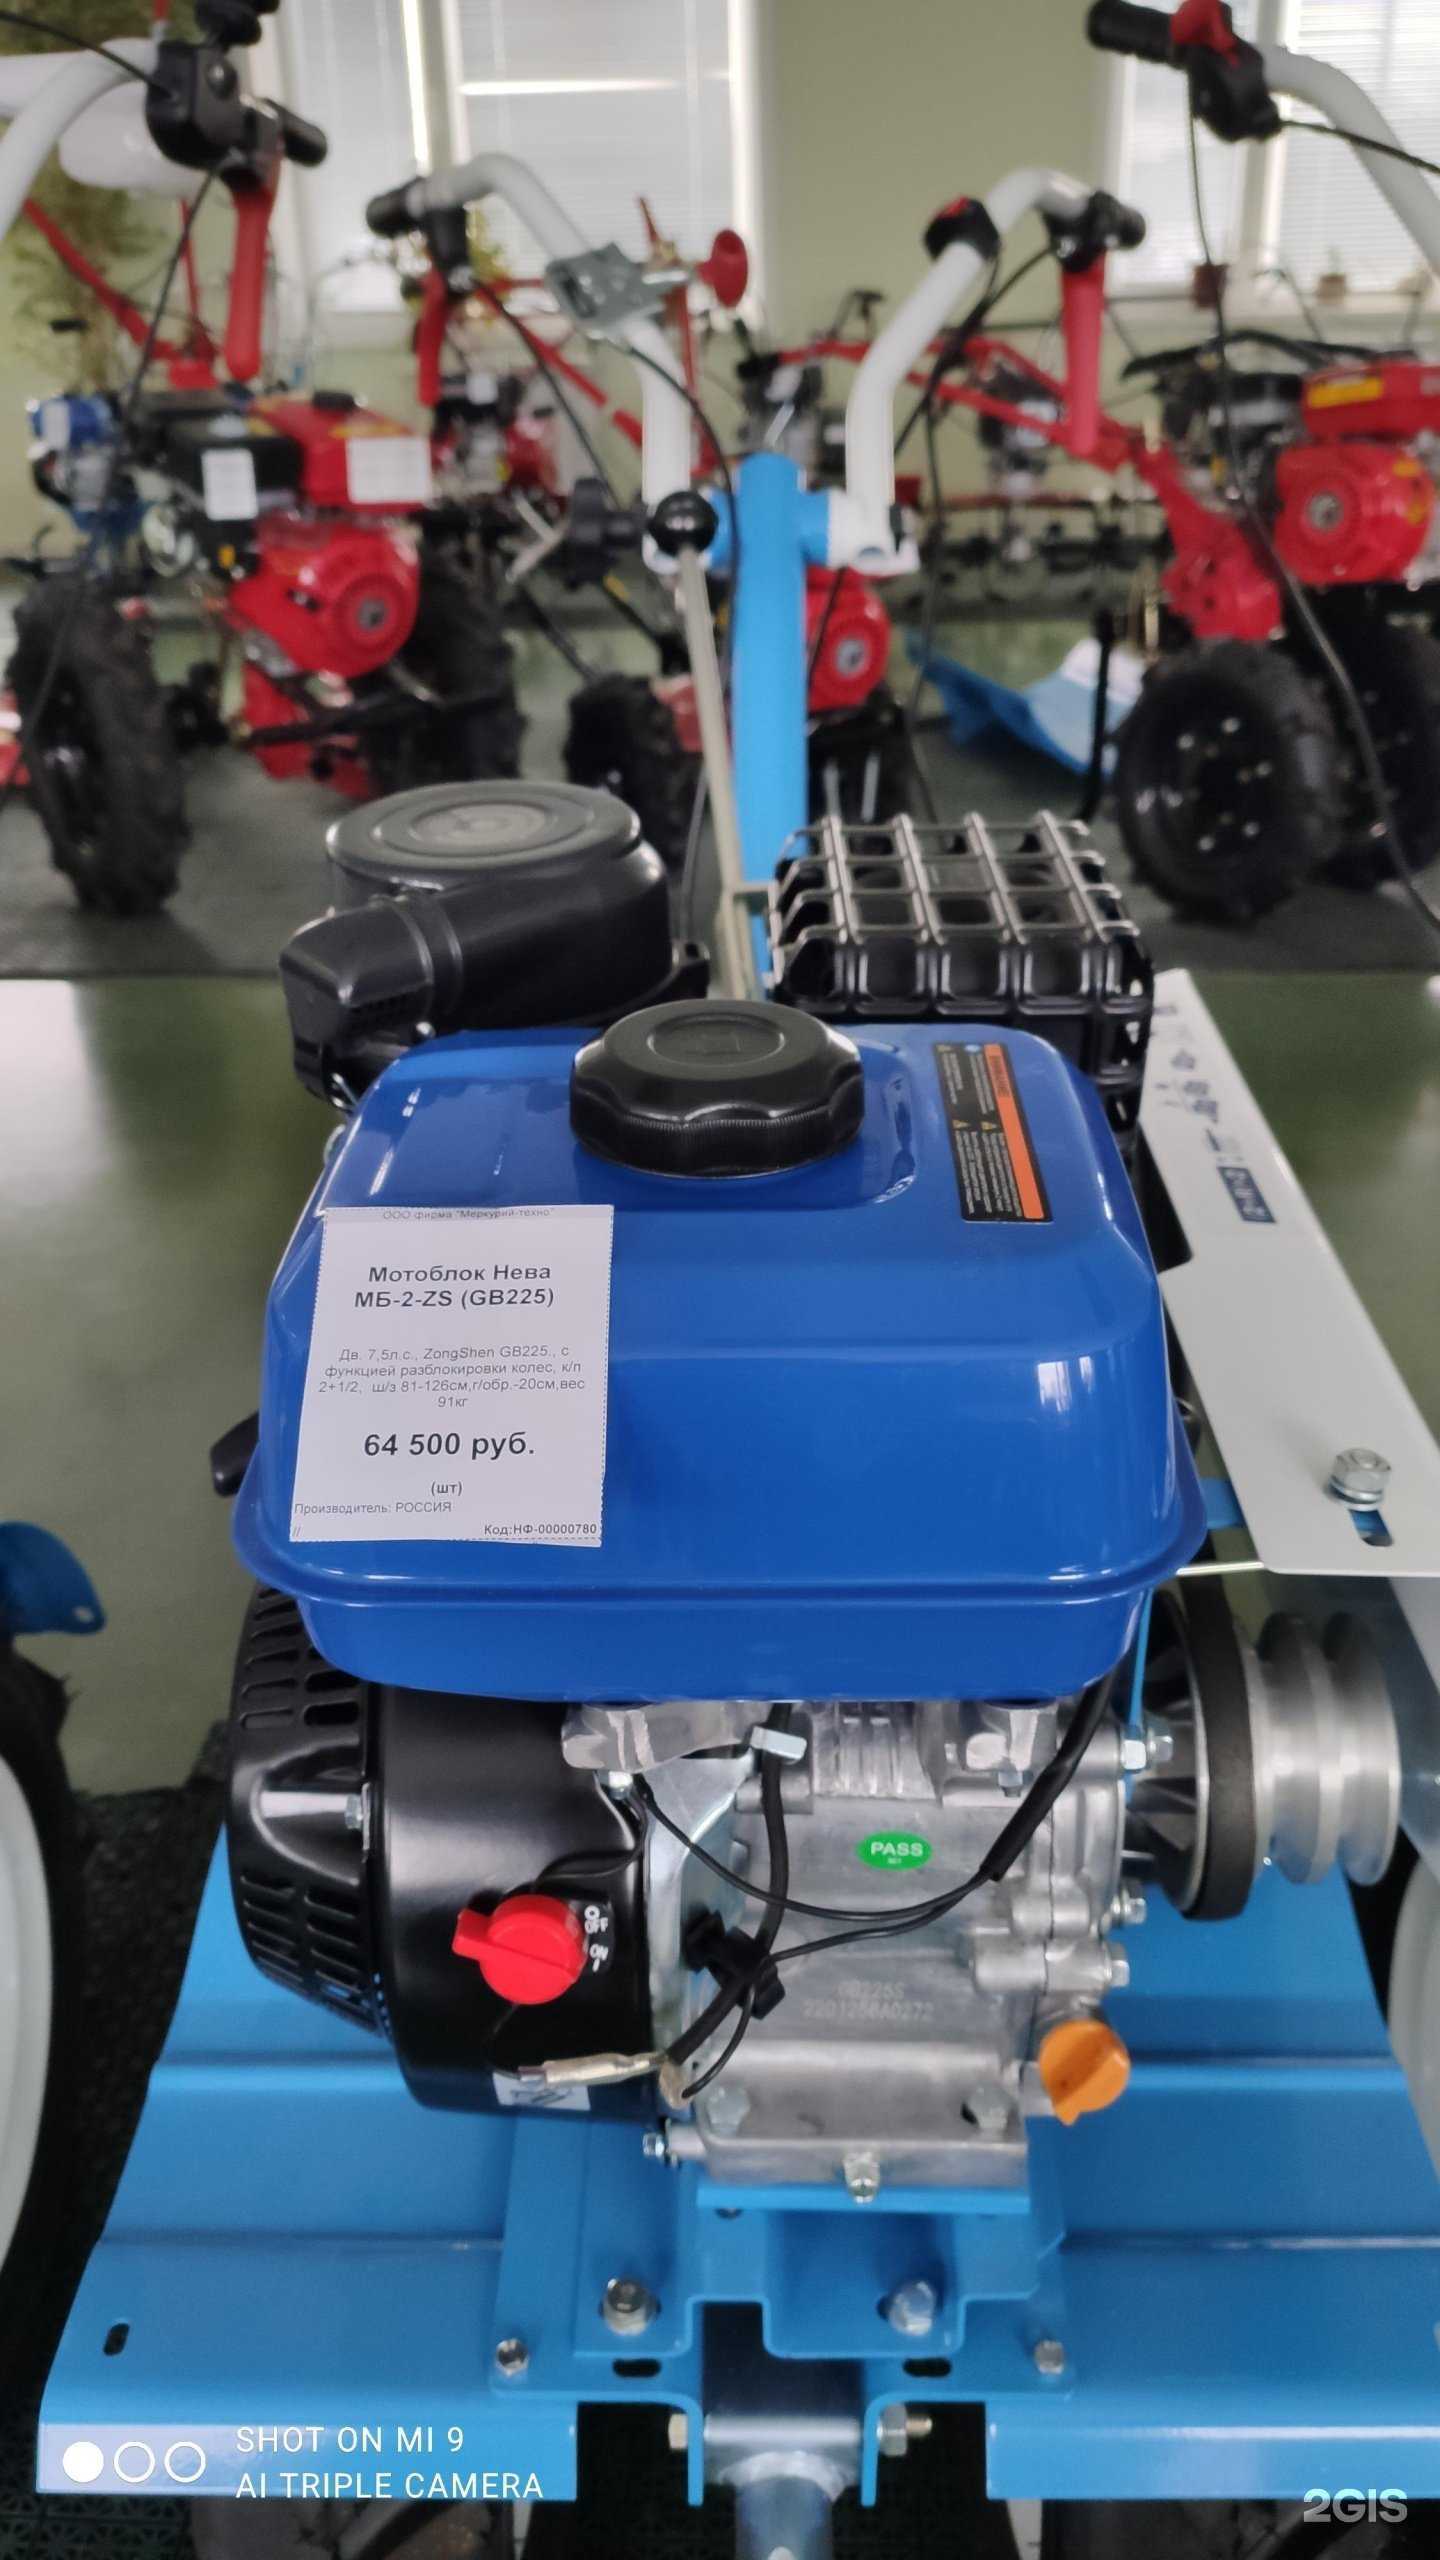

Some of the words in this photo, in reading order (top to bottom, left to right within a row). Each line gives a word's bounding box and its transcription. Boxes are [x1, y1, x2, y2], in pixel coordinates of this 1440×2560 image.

[383, 1210, 411, 1220] ООО
[414, 1210, 453, 1221] фирма
[368, 1266, 486, 1282] Мотоблок
[493, 1265, 551, 1280] Нева
[354, 1290, 453, 1308] МБ-2-ZS
[461, 1288, 554, 1309] (GB225)
[339, 1350, 361, 1362] Дв.
[423, 1346, 495, 1361] ZongShen
[561, 1347, 569, 1356] с
[324, 1365, 396, 1378] функцией
[400, 1362, 507, 1377] разблокировки
[561, 1360, 582, 1374] к/п
[318, 1380, 363, 1394] 2+1/2,
[371, 1379, 396, 1393] ш/з
[437, 1397, 468, 1408] 91кг
[364, 1433, 398, 1456] 64
[408, 1432, 461, 1456] 500
[471, 1431, 535, 1461] руб.
[430, 1481, 463, 1496] (шт)
[294, 1503, 391, 1515] Производитель:
[395, 1502, 452, 1513] РОССИЯ
[484, 1524, 597, 1536] Код:НФ-00000780
[870, 1841, 924, 1858] PASS
[584, 1917, 609, 1935] OFF
[589, 1943, 609, 1961] ON
